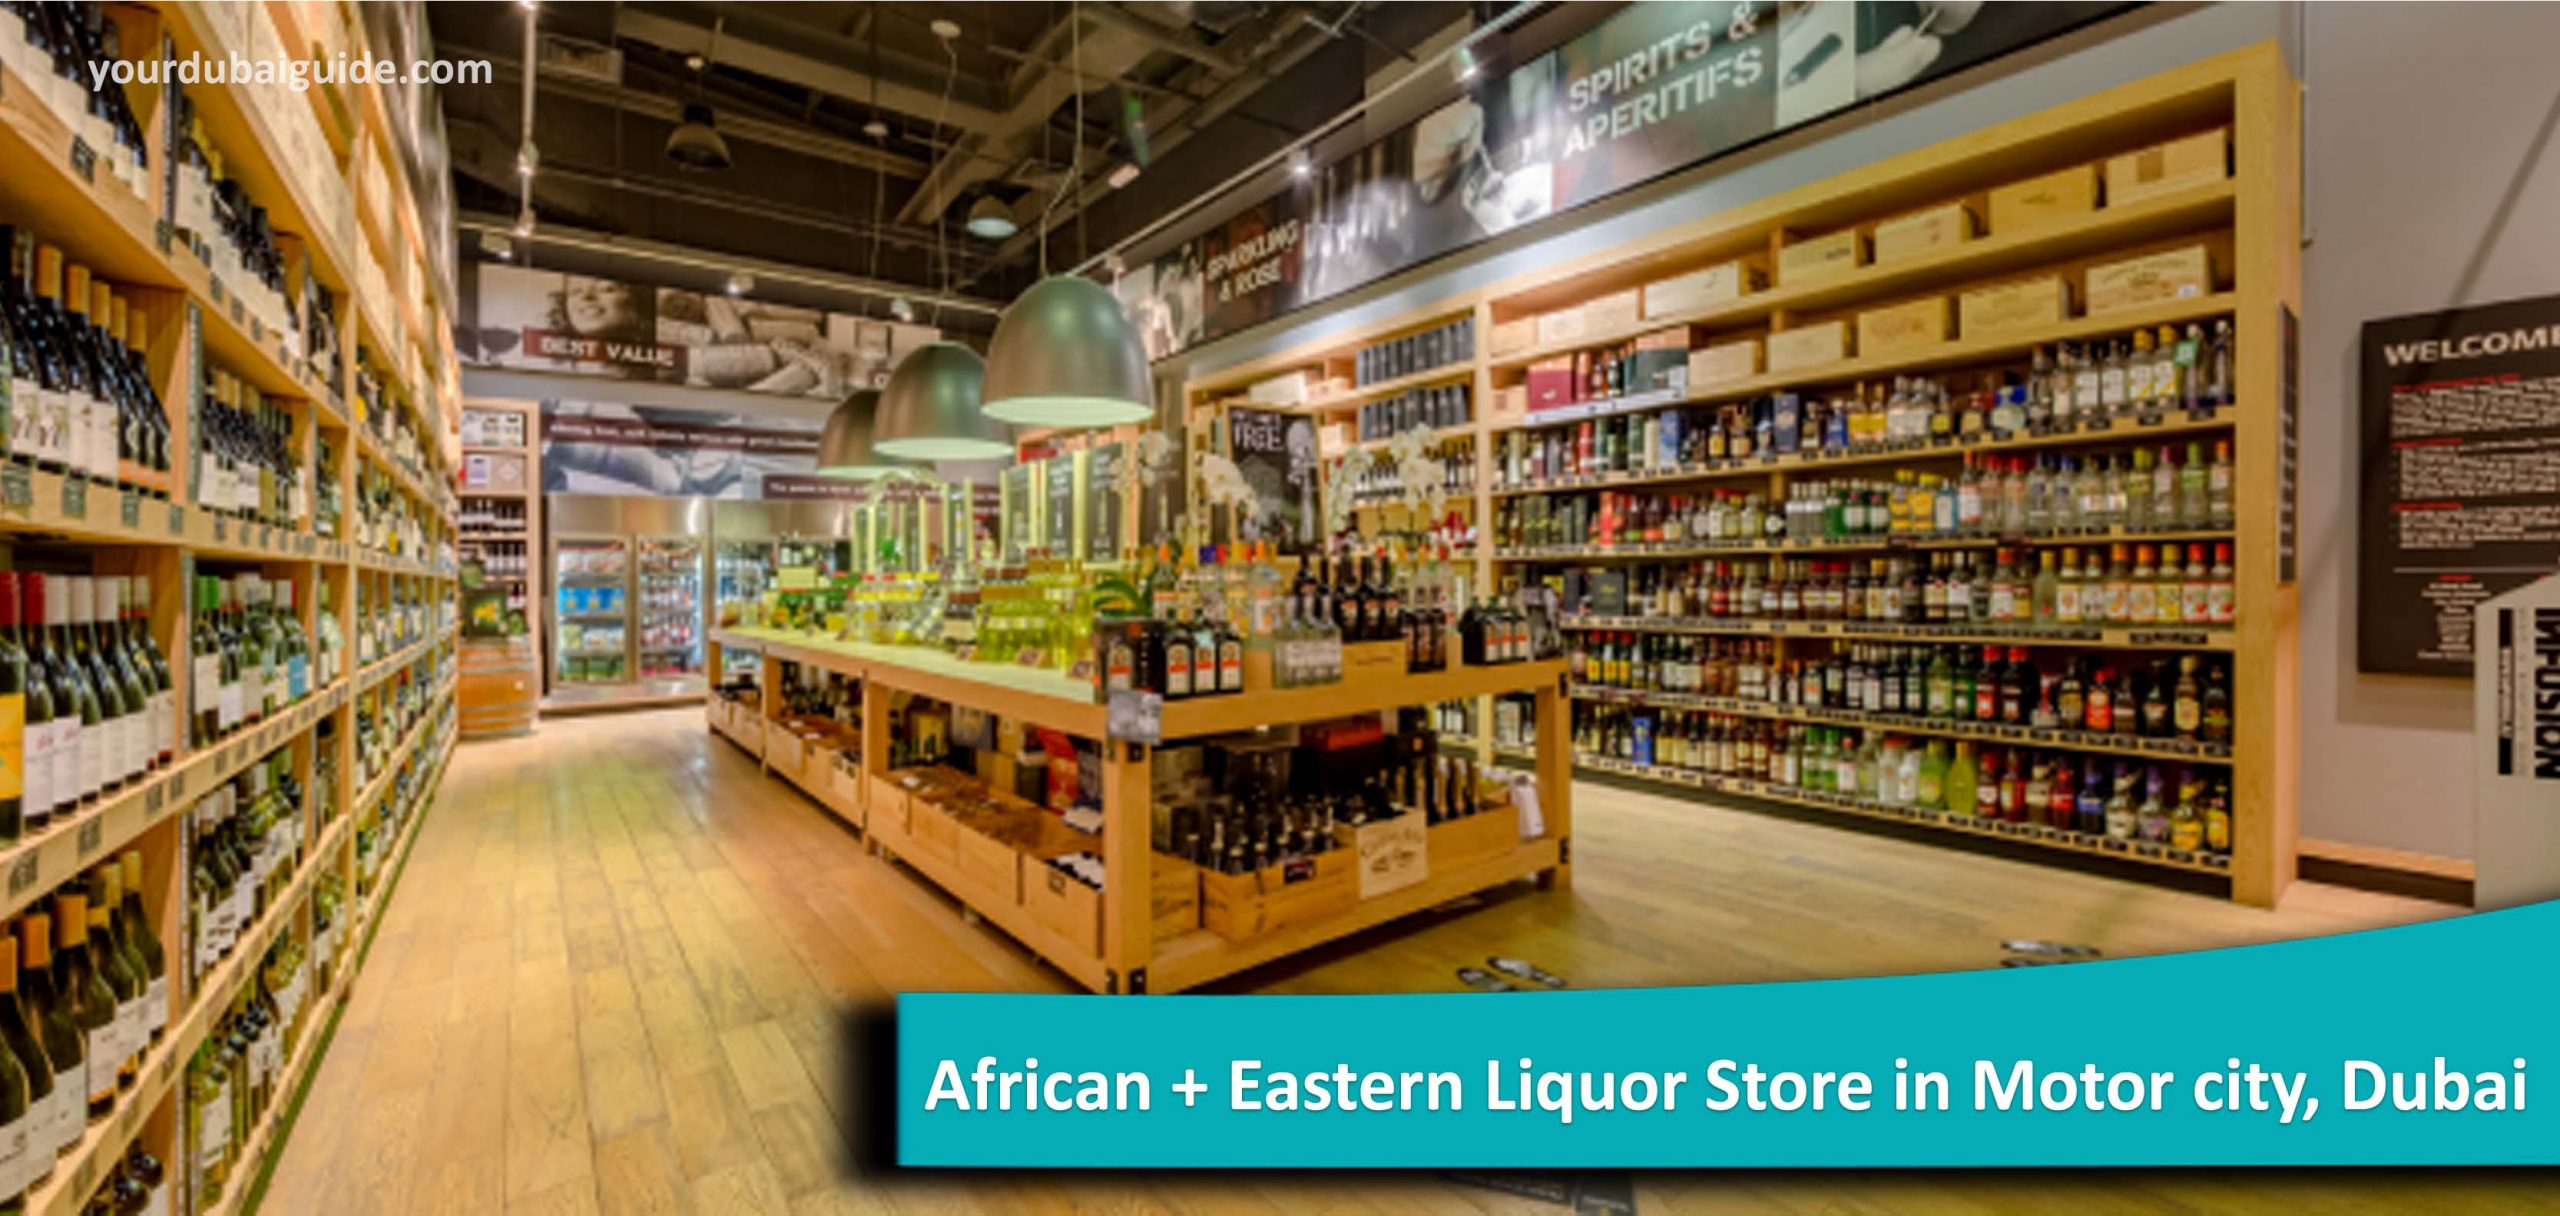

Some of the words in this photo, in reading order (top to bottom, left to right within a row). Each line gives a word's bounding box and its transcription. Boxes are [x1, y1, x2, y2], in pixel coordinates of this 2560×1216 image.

[1568, 19, 1712, 113] SPIRITS
[1728, 2, 1759, 42] &
[1562, 46, 1763, 160] APERITIFS
[1206, 218, 1299, 282] SPARKLING
[540, 335, 599, 358] BEST
[605, 342, 675, 368] VALUE
